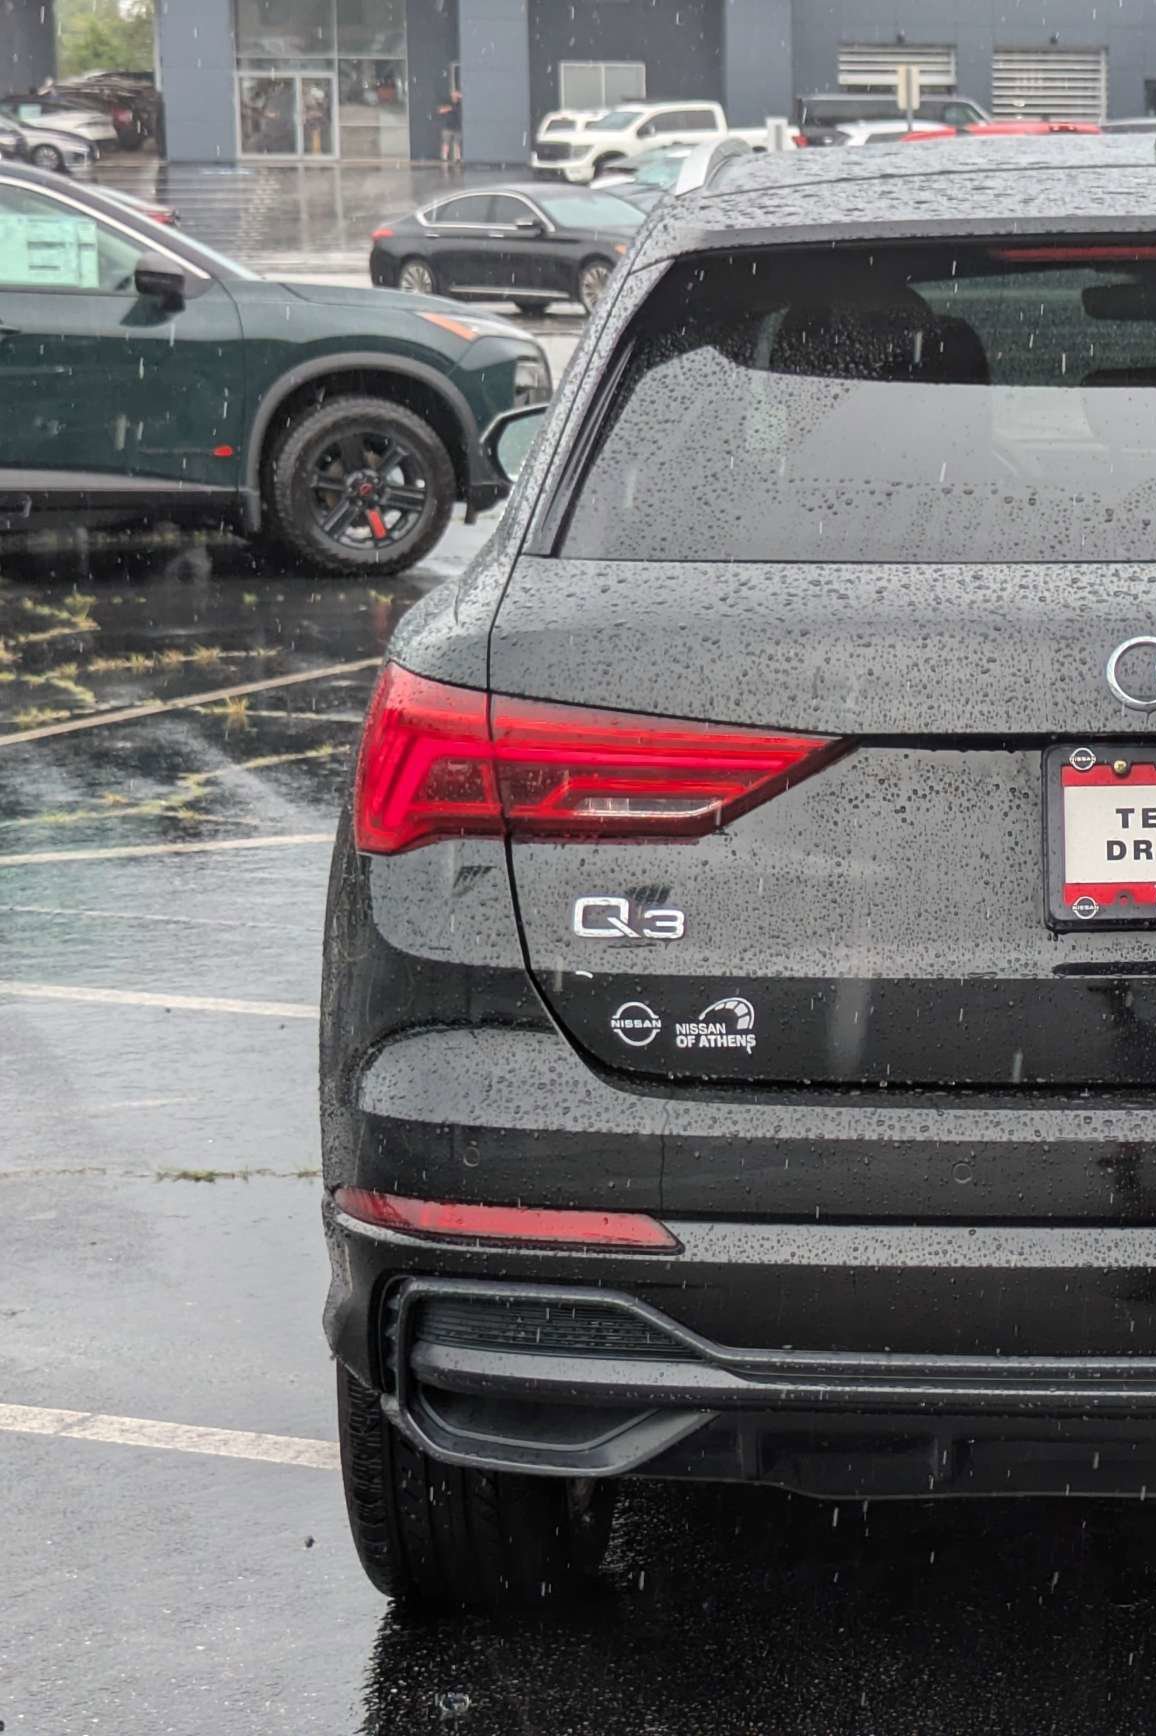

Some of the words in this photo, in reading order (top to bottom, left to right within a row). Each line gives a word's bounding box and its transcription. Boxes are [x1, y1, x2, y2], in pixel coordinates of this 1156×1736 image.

[573, 896, 685, 939] Q3
[610, 1018, 662, 1028] NISSAN
[675, 1023, 726, 1036] NISSAN
[675, 1035, 696, 1048] OF
[698, 1034, 757, 1048] ATHENS
